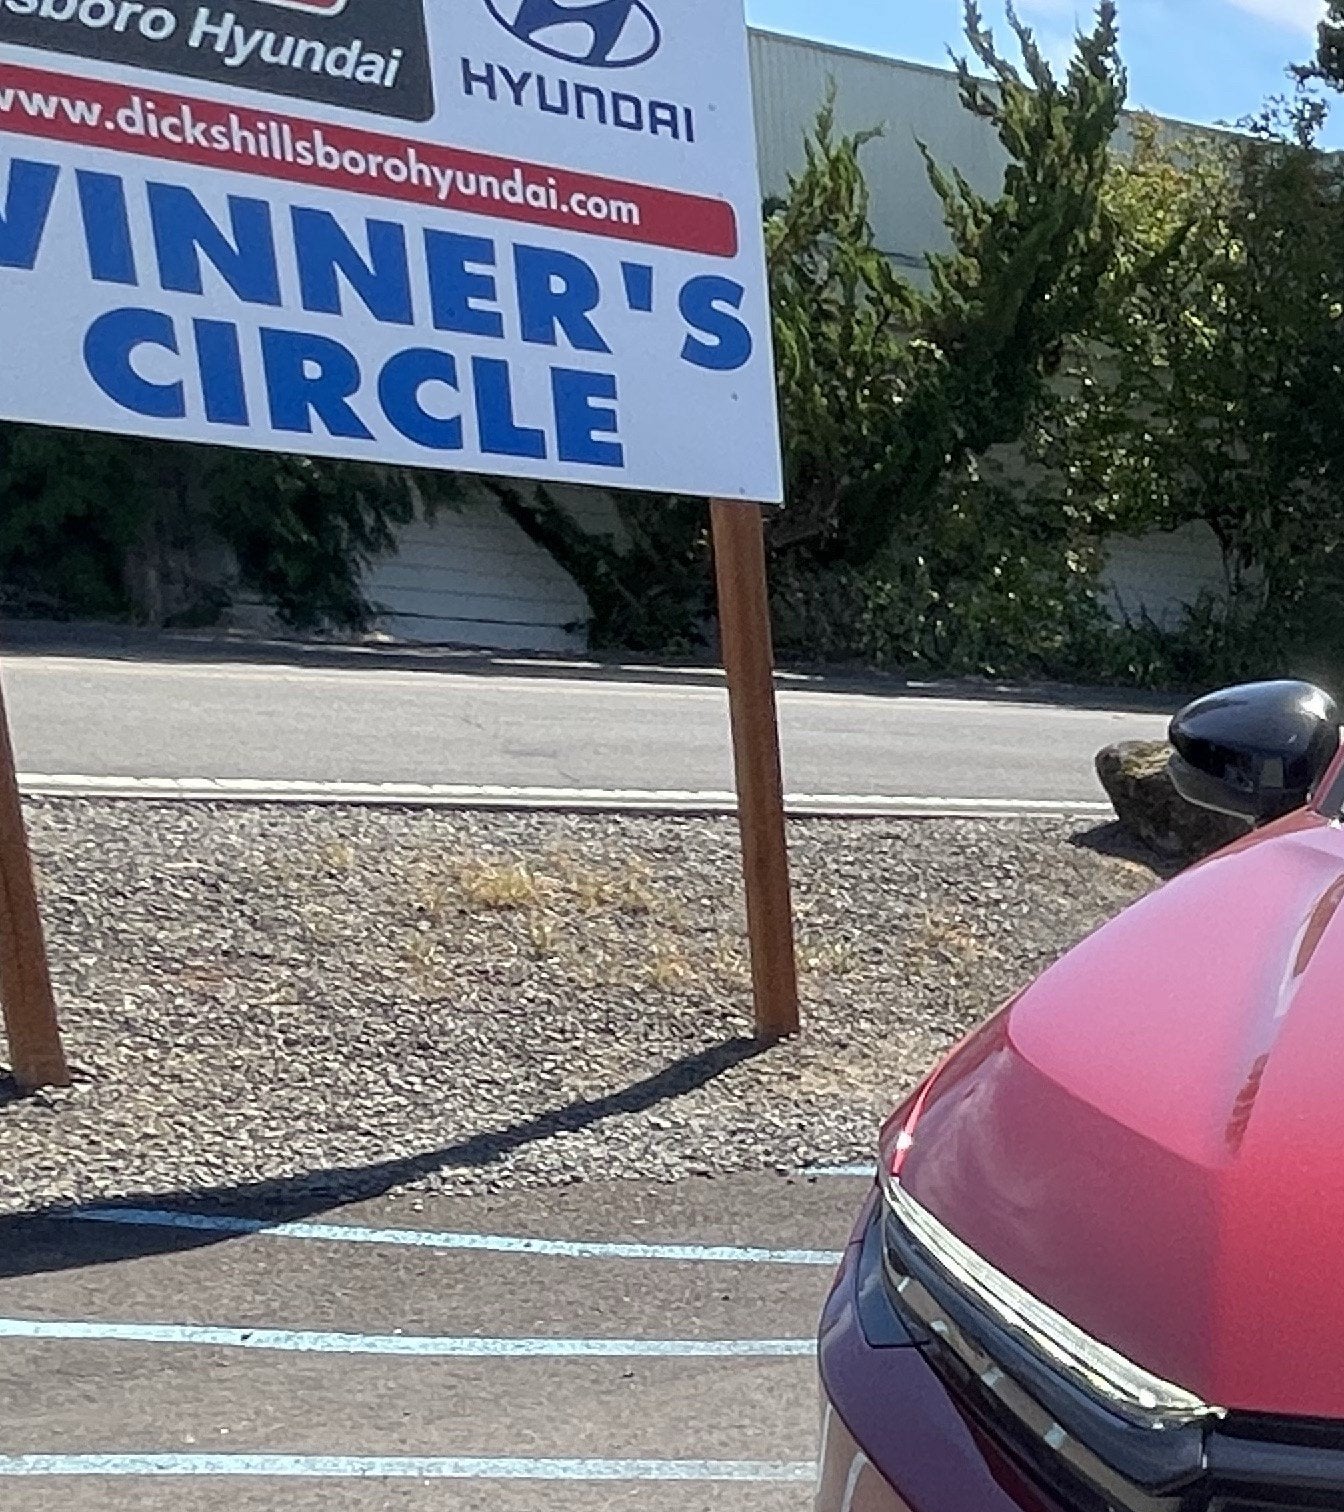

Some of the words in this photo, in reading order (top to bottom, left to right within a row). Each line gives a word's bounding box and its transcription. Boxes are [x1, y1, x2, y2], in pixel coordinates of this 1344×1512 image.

[188, 6, 402, 88] Hyundai
[461, 57, 696, 144] HYUNDAI
[83, 306, 624, 468] CIRCLE
